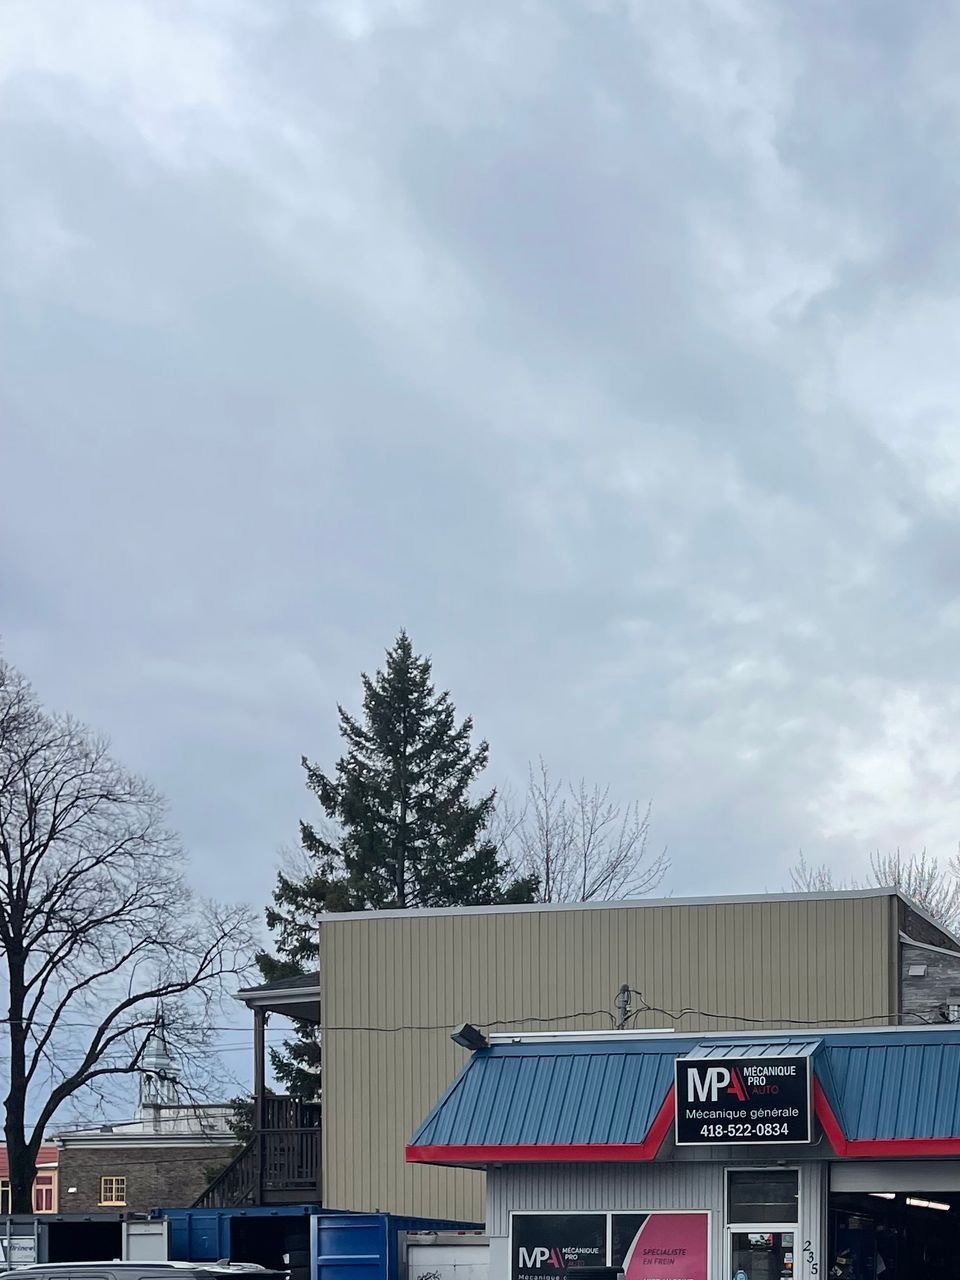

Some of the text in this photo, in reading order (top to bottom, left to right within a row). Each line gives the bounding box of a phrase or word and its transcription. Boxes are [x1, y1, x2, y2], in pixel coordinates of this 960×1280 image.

[743, 1065, 797, 1076] MÉCANIQUE
[687, 1067, 749, 1102] MPA
[748, 1076, 766, 1086] PRO
[752, 1085, 780, 1095] AUTO
[686, 1107, 799, 1120] Mécanique générale
[700, 1123, 789, 1137] 418-522-0834
[518, 1247, 564, 1268] MPA
